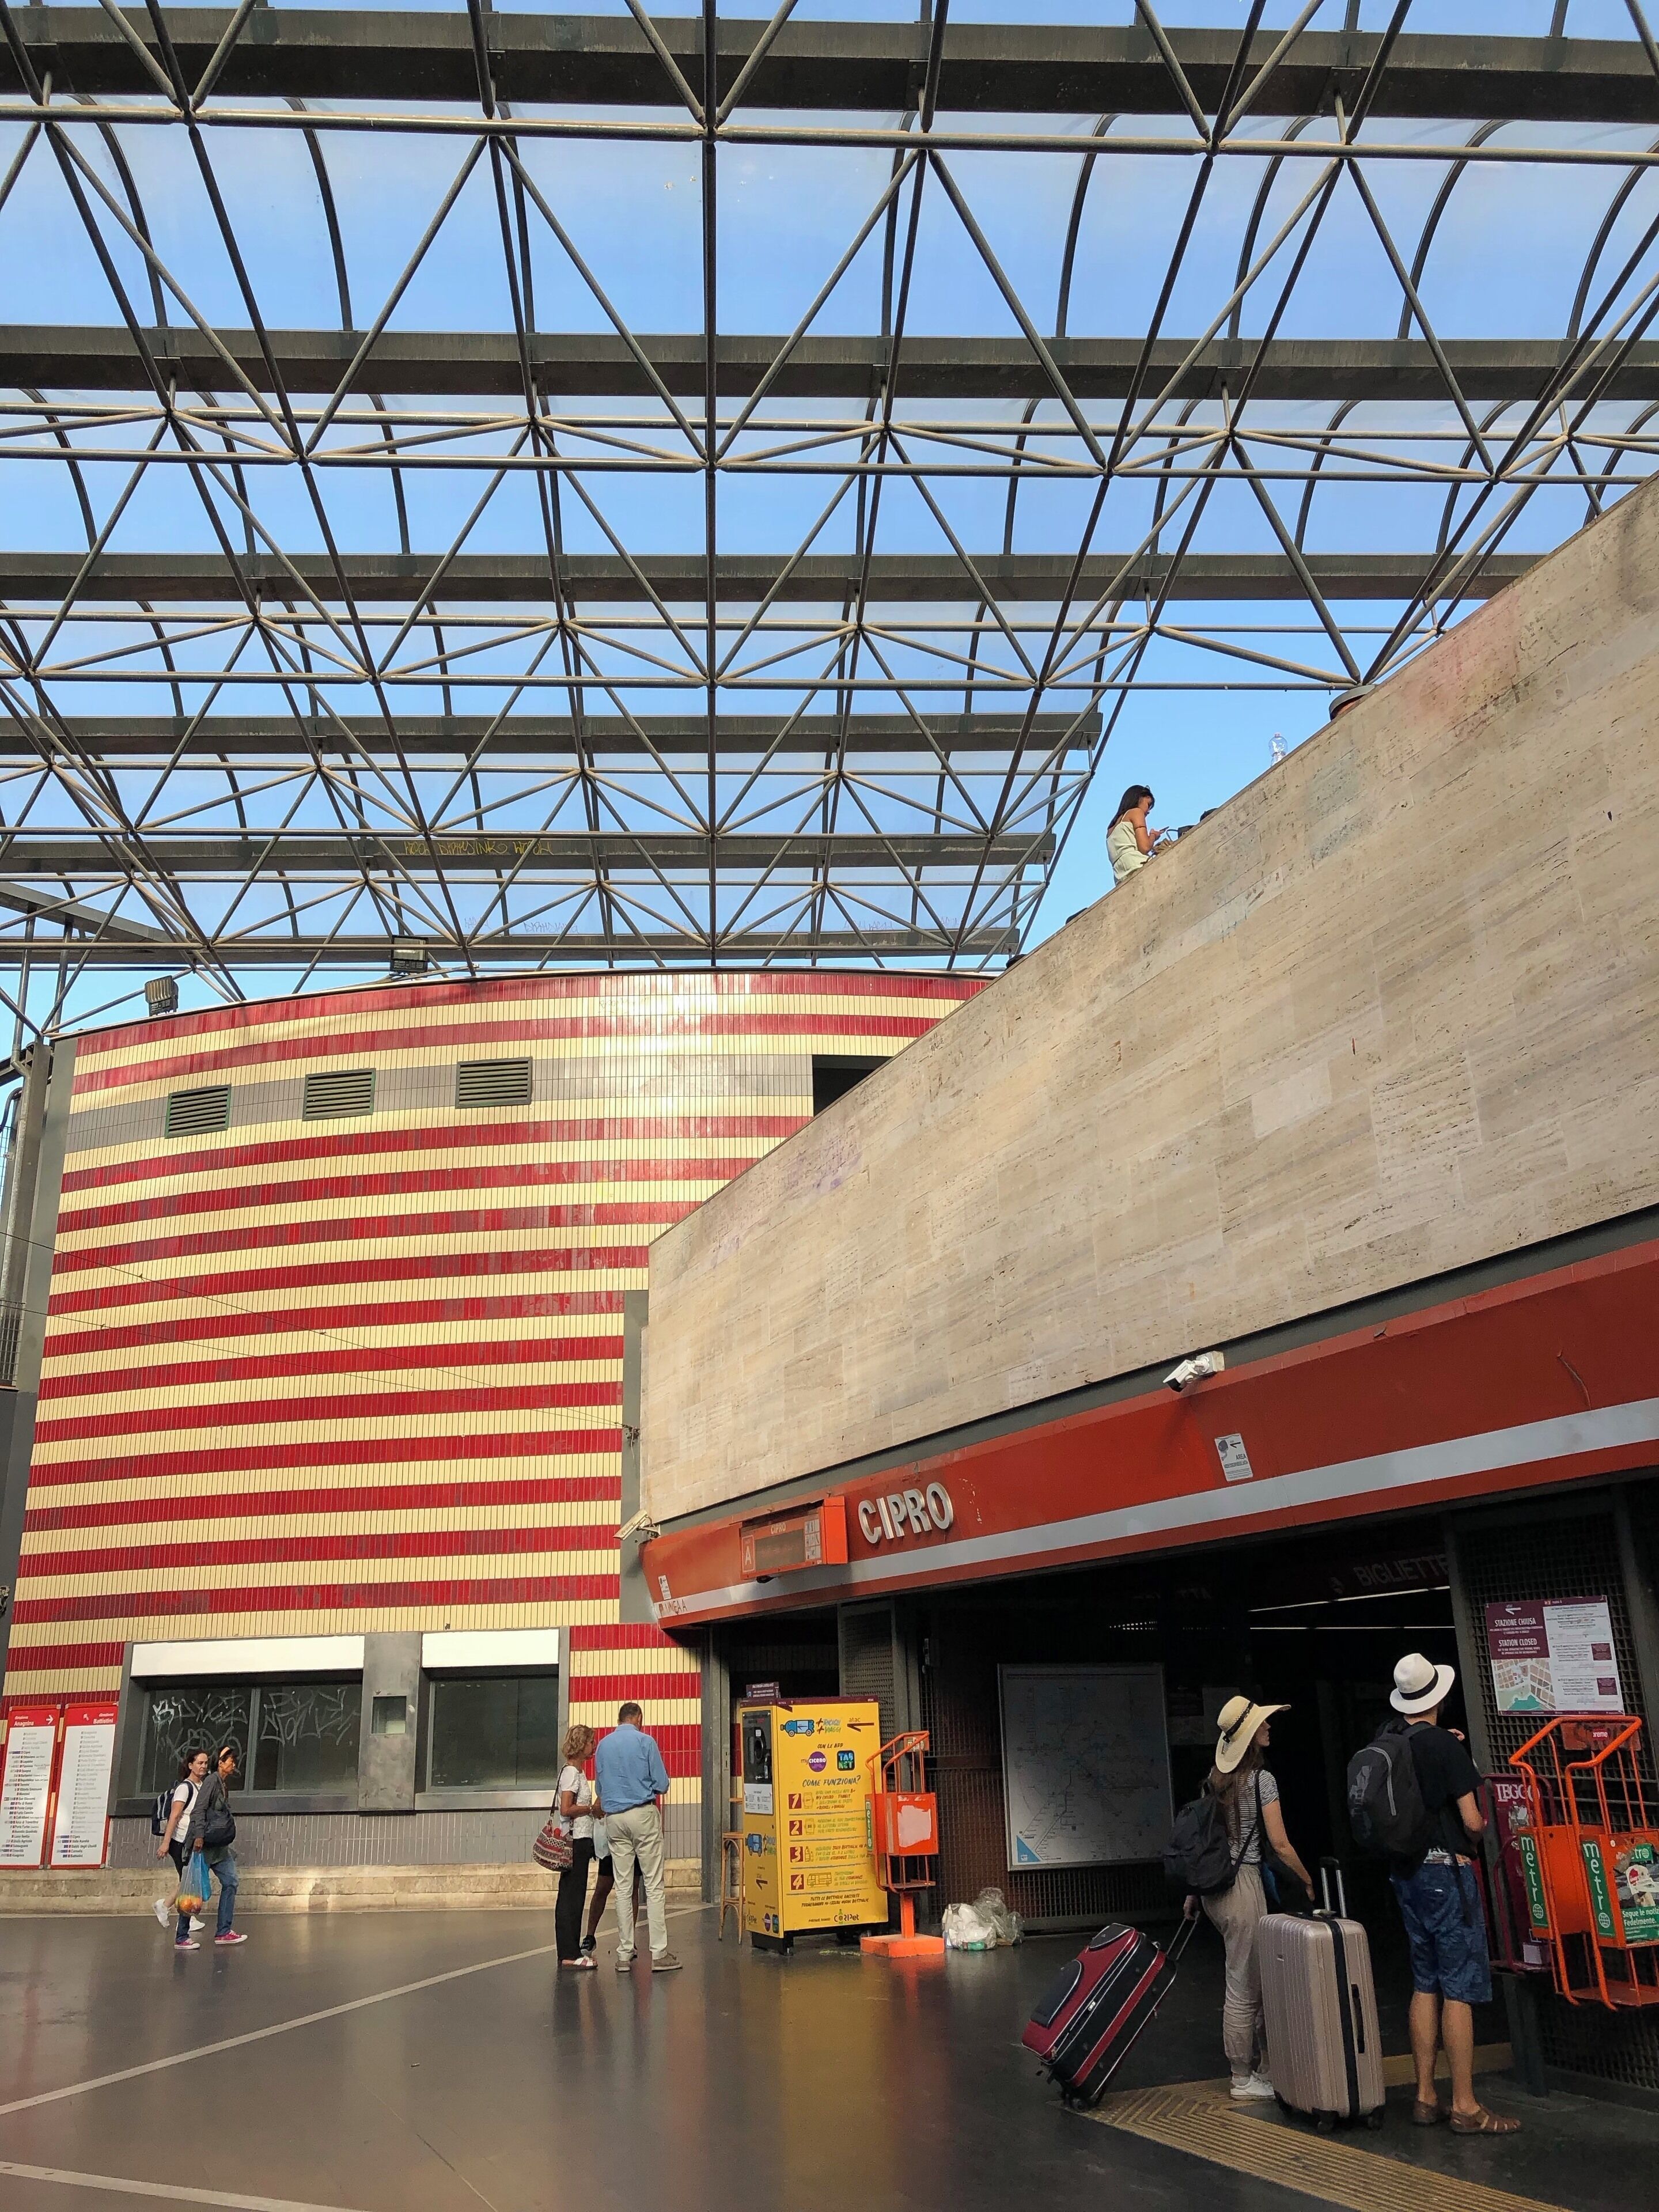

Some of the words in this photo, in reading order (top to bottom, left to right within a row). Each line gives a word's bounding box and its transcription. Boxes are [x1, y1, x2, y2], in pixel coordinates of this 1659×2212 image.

[858, 1482, 954, 1544] CIPRO
[770, 1522, 786, 1535] CIPRO
[745, 1546, 752, 1565] A
[1495, 1619, 1517, 1627] STAZIONE
[1498, 1639, 1518, 1647] STATION
[839, 1753, 853, 1761] TAB
[802, 1779, 820, 1787] COME
[823, 1775, 861, 1786] FUNZIONA?
[792, 1794, 799, 1809] 1
[791, 1821, 800, 1835] 2
[791, 1847, 801, 1862] 3
[793, 1874, 802, 1889] 4
[1622, 1908, 1639, 1920] Segue
[1624, 1917, 1657, 1926] Fedelmente.
